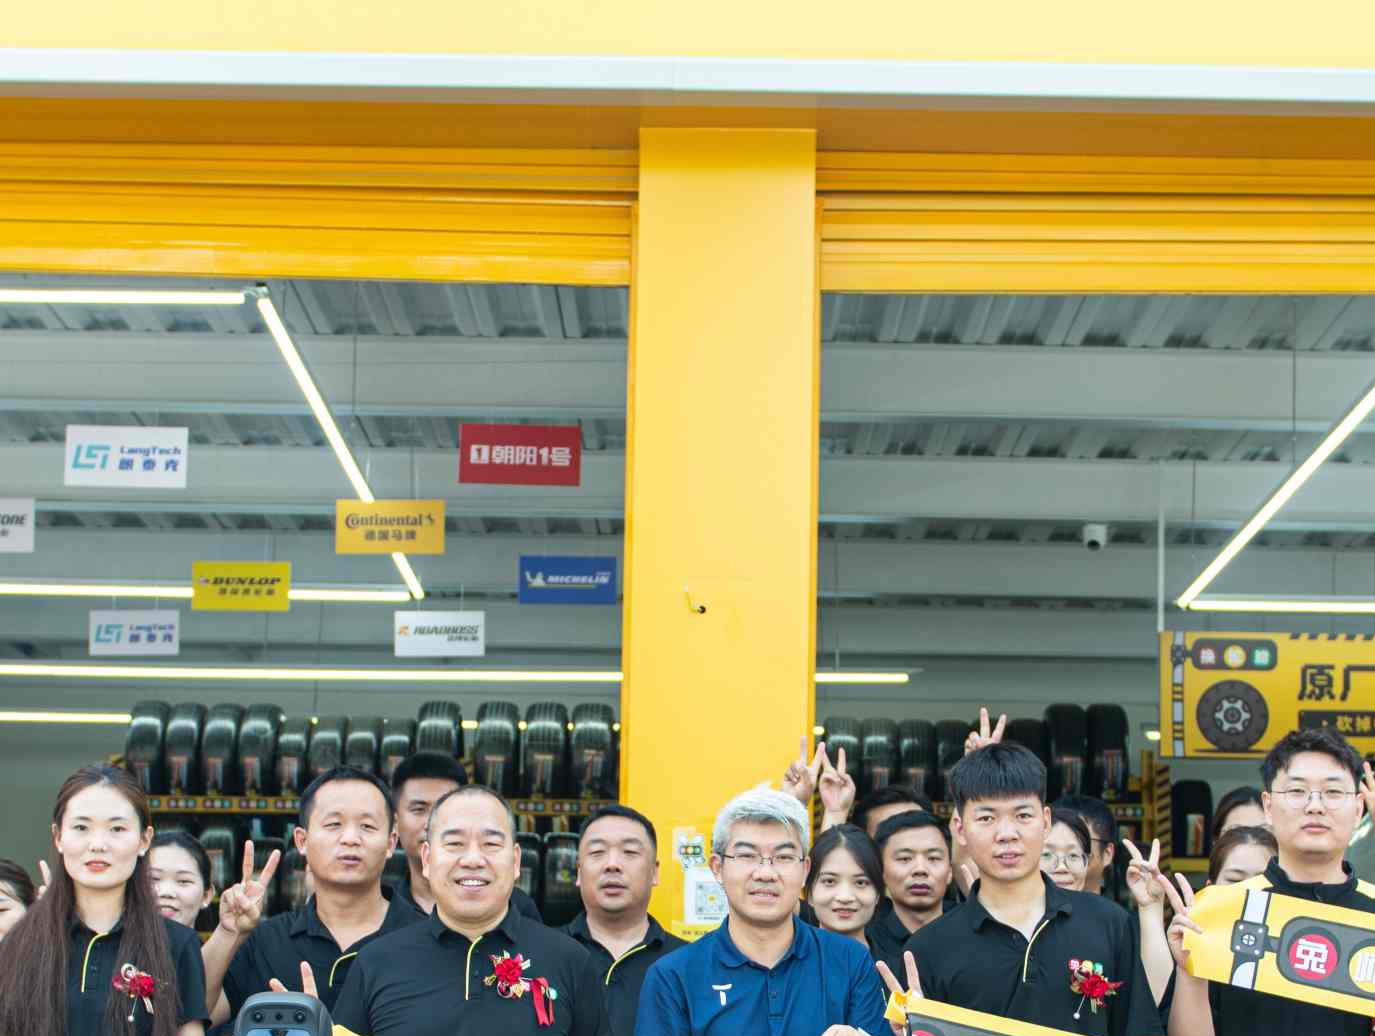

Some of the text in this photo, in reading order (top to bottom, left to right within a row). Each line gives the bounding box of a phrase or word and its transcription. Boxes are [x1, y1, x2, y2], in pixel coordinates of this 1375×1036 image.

[119, 446, 181, 456] LangTech
[492, 445, 572, 466] 朝阳1号
[118, 458, 179, 472] 朗泰克
[345, 513, 422, 528] Continental
[212, 577, 281, 585] DUNLOP
[547, 574, 610, 584] MICHELIN
